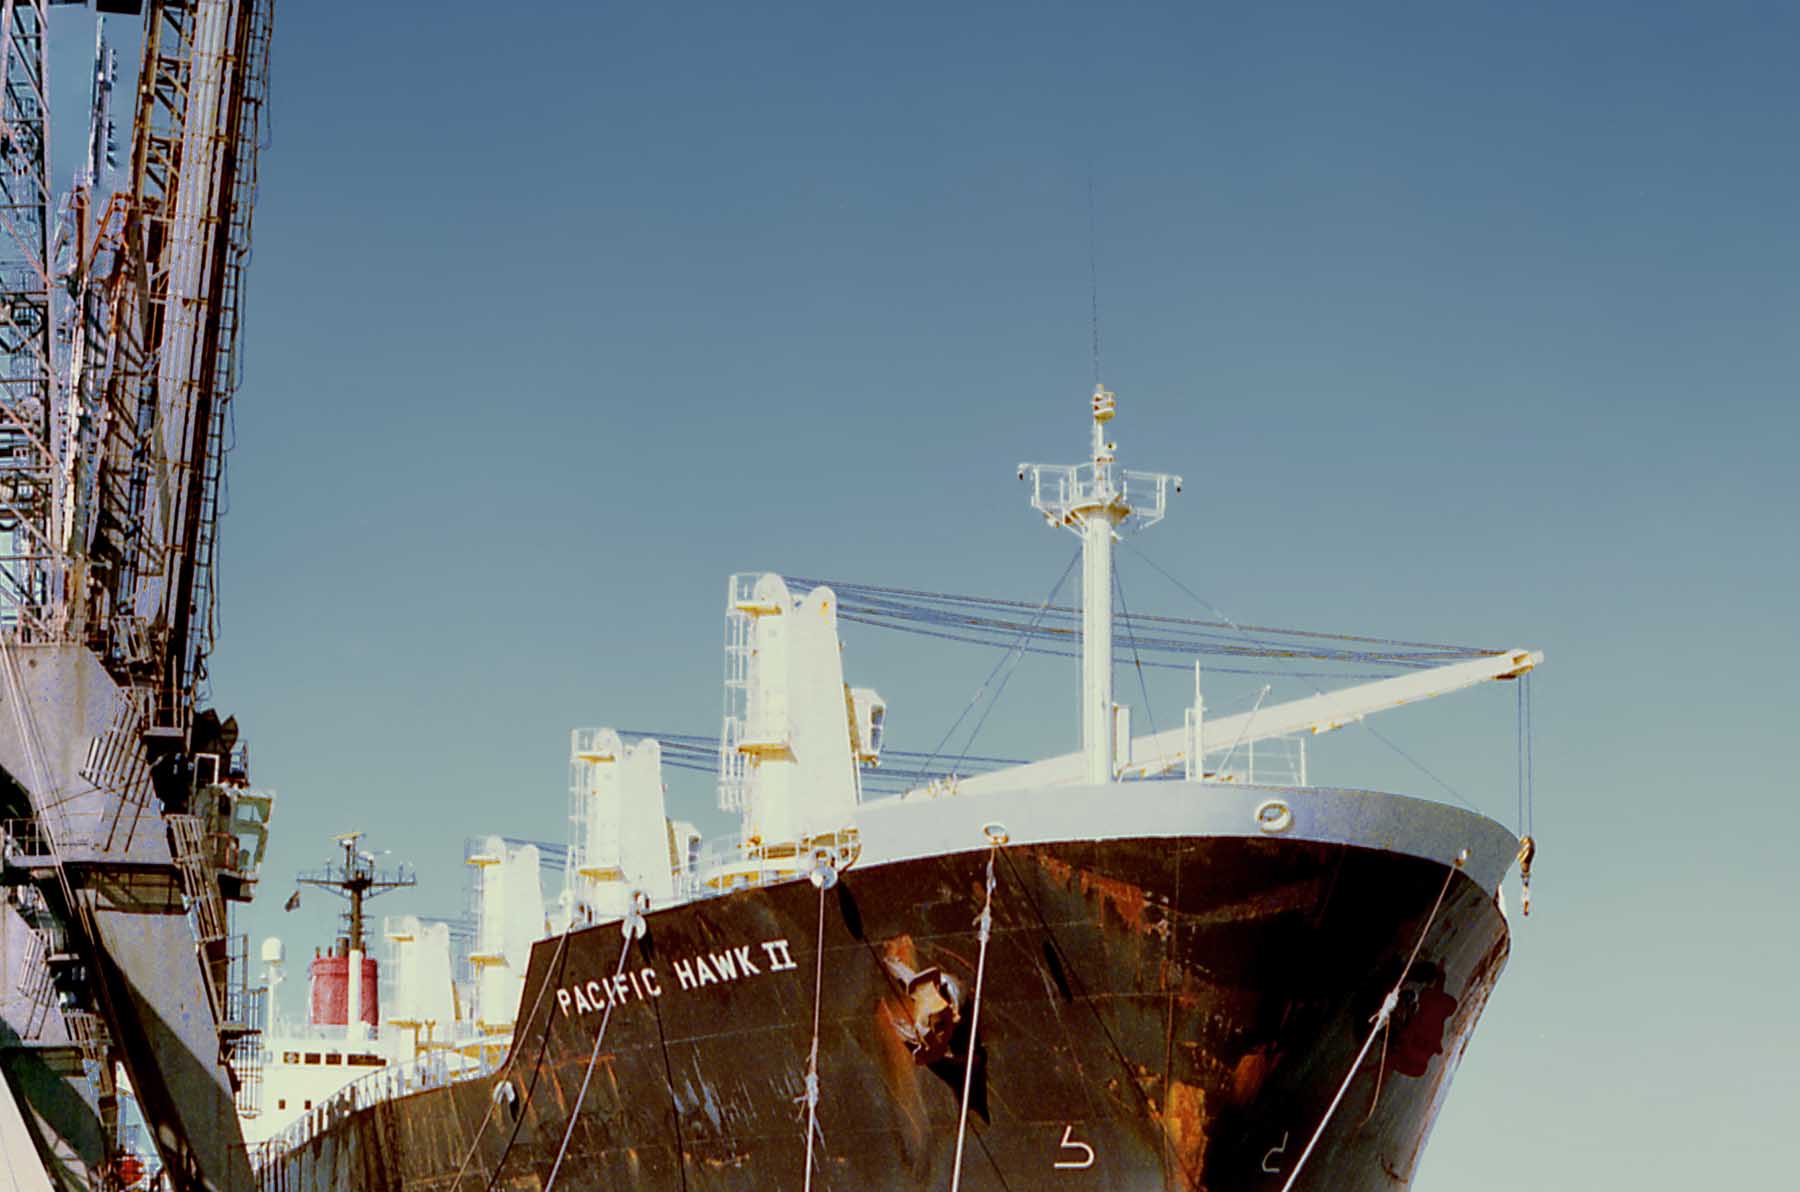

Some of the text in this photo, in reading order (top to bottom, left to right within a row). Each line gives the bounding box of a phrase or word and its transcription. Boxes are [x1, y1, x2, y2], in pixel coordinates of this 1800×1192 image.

[556, 939, 798, 1017] PACIFIC HAWK II
